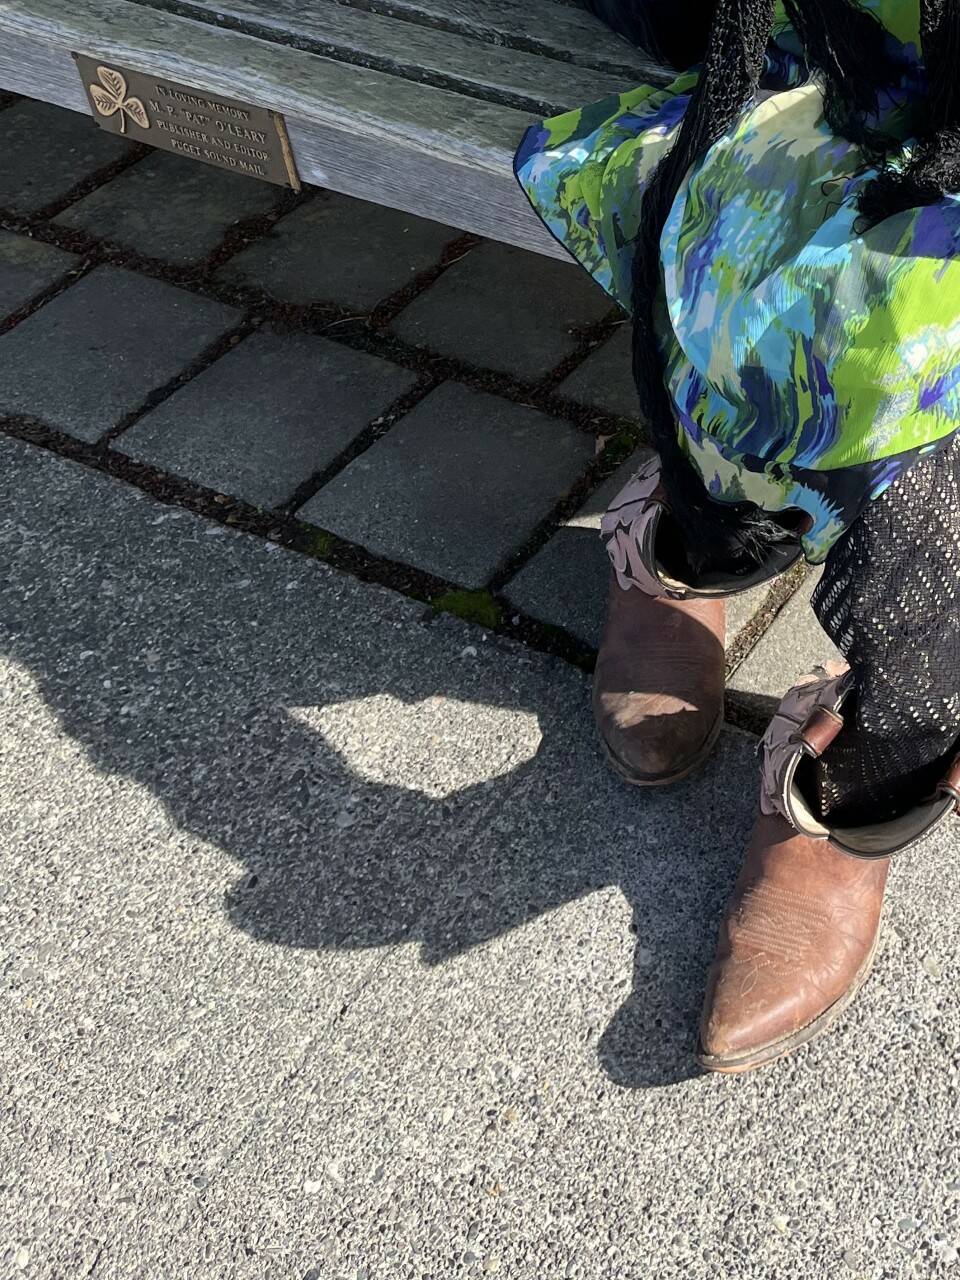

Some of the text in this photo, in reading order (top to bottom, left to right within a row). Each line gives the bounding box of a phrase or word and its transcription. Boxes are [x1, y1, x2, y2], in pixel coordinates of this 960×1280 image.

[155, 85, 250, 122] IN LOVING MEMORY
[156, 119, 269, 161] PUBLISHER AND EDITOR
[215, 120, 267, 144] O'LEARY
[171, 139, 265, 176] PUGET SOUND MAIL
